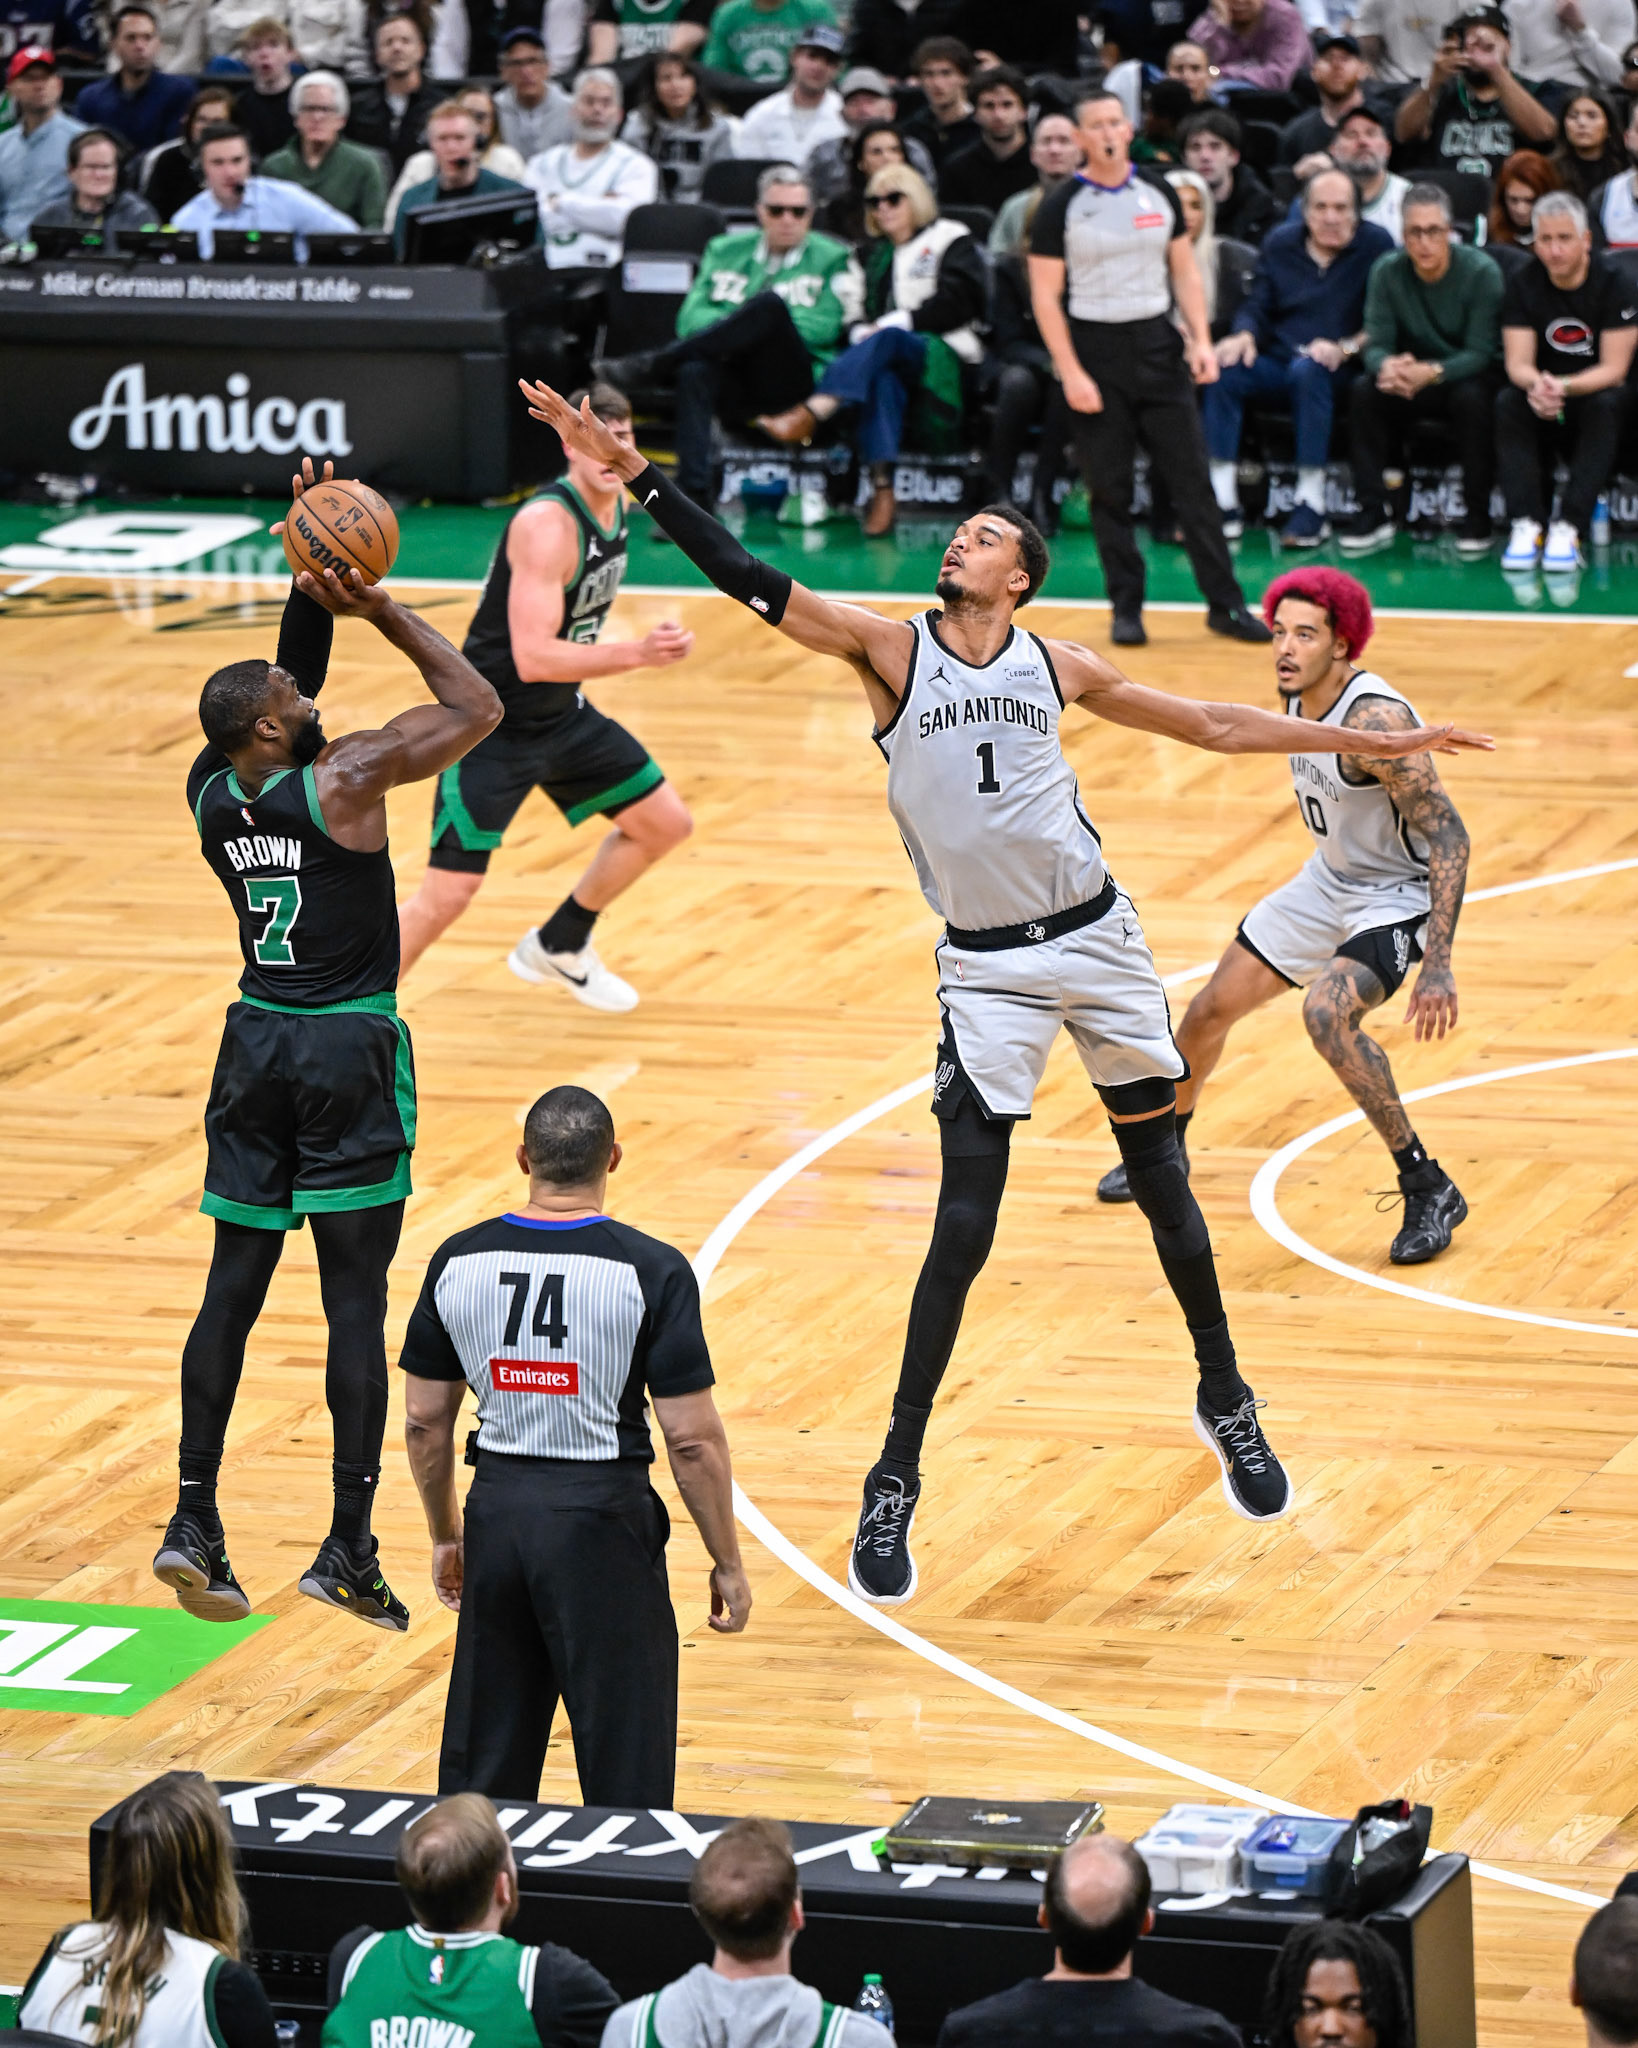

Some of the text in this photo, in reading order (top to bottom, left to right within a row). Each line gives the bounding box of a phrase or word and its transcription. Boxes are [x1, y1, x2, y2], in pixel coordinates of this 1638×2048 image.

[41, 271, 94, 296] Mike
[95, 272, 185, 298] Gorman
[187, 274, 297, 300] Broadcast
[301, 276, 361, 303] Table
[68, 362, 354, 457] Amica
[295, 513, 352, 580] Wilson
[1008, 669, 1037, 678] LEDGER
[919, 696, 1048, 739] SAN ANTONIO
[975, 741, 1001, 795] 1
[223, 835, 301, 872] BROWN
[243, 876, 302, 965] 7
[499, 1272, 568, 1349] 74
[499, 1366, 570, 1387] Emirates
[370, 2015, 475, 2048] BROWN
